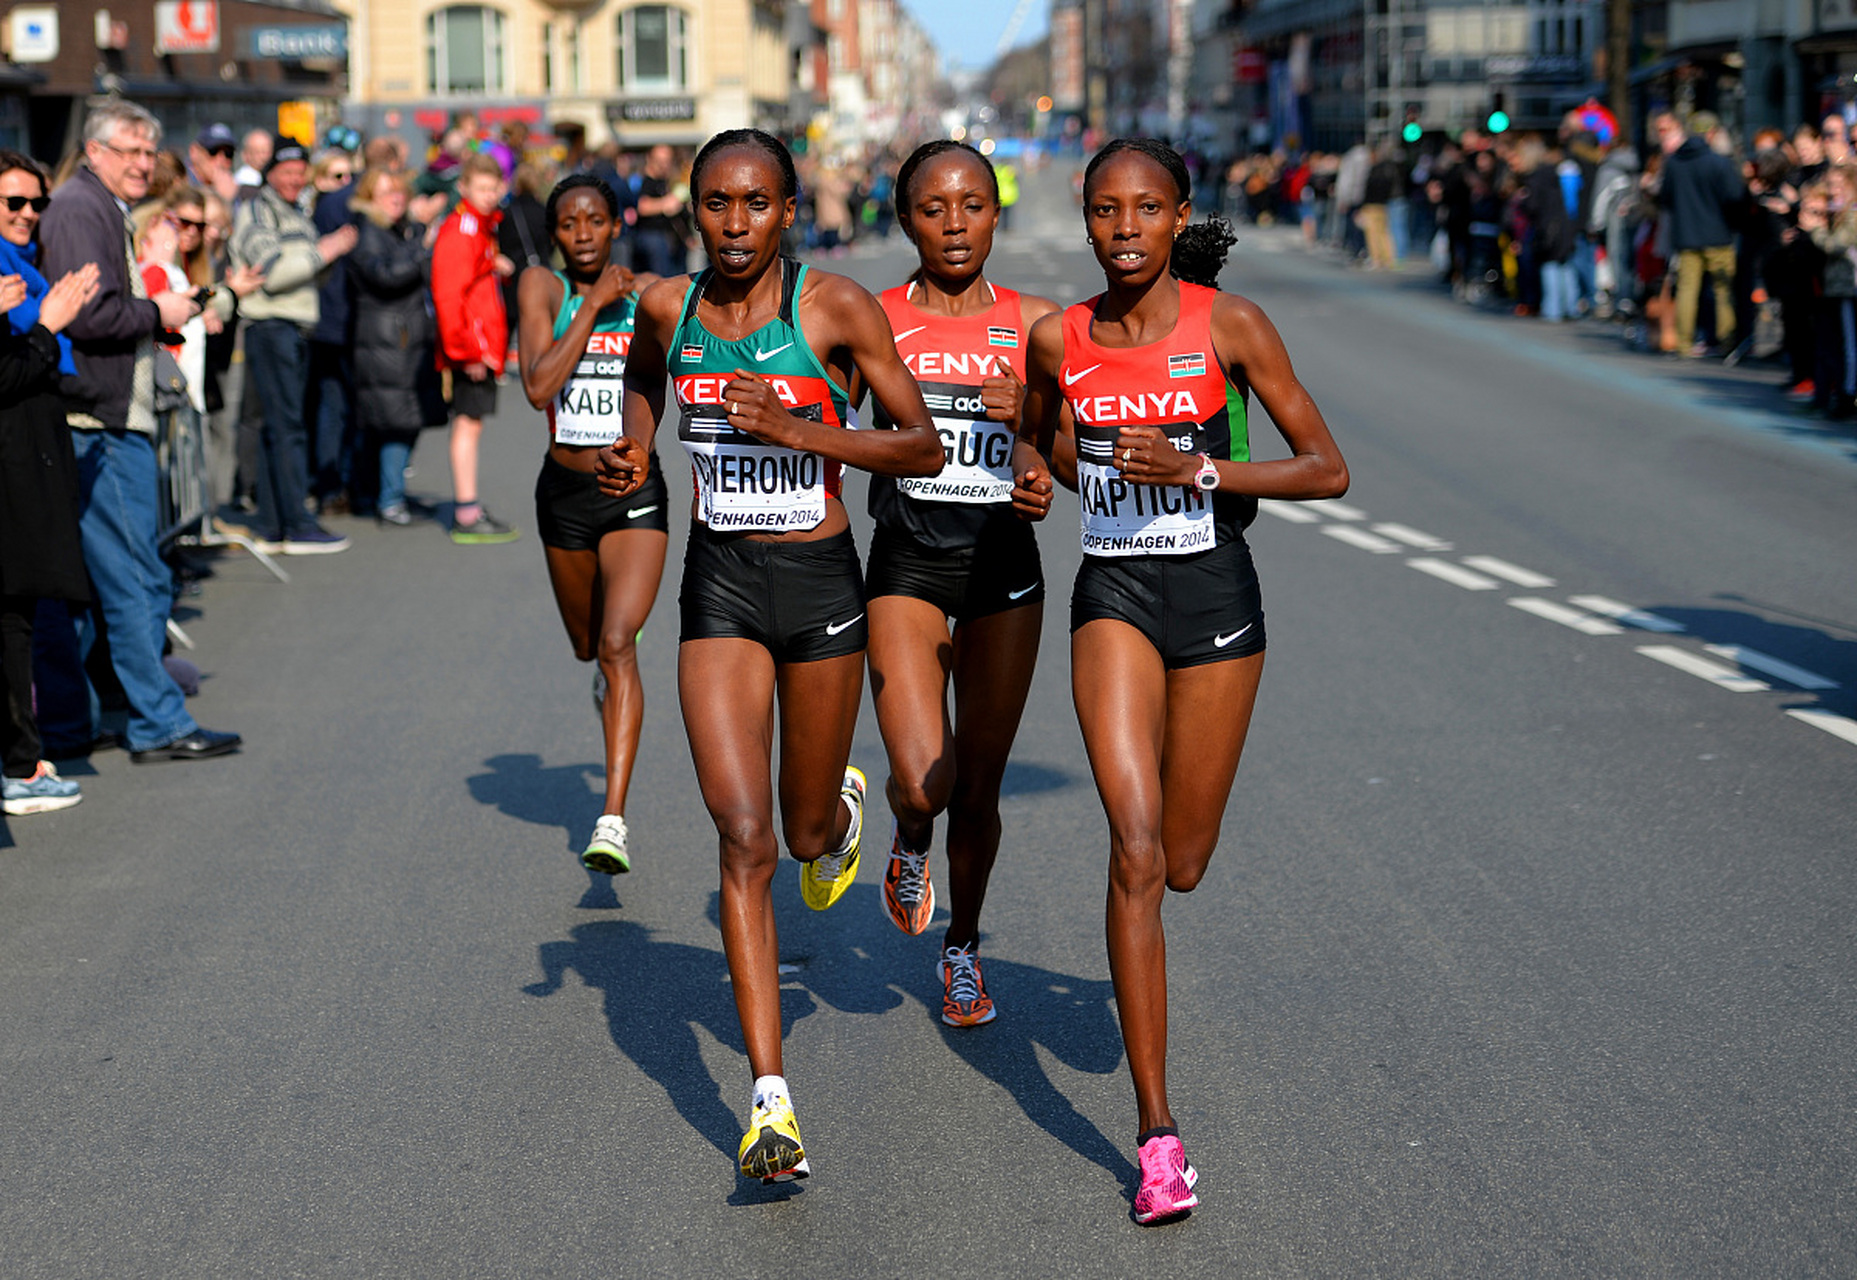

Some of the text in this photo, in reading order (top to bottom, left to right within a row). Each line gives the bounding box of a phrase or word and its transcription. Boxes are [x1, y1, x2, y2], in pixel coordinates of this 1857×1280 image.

[1073, 391, 1199, 422] KENYA
[789, 509, 819, 525] 2014
[1083, 525, 1210, 550] COPENHAGEN 2014
